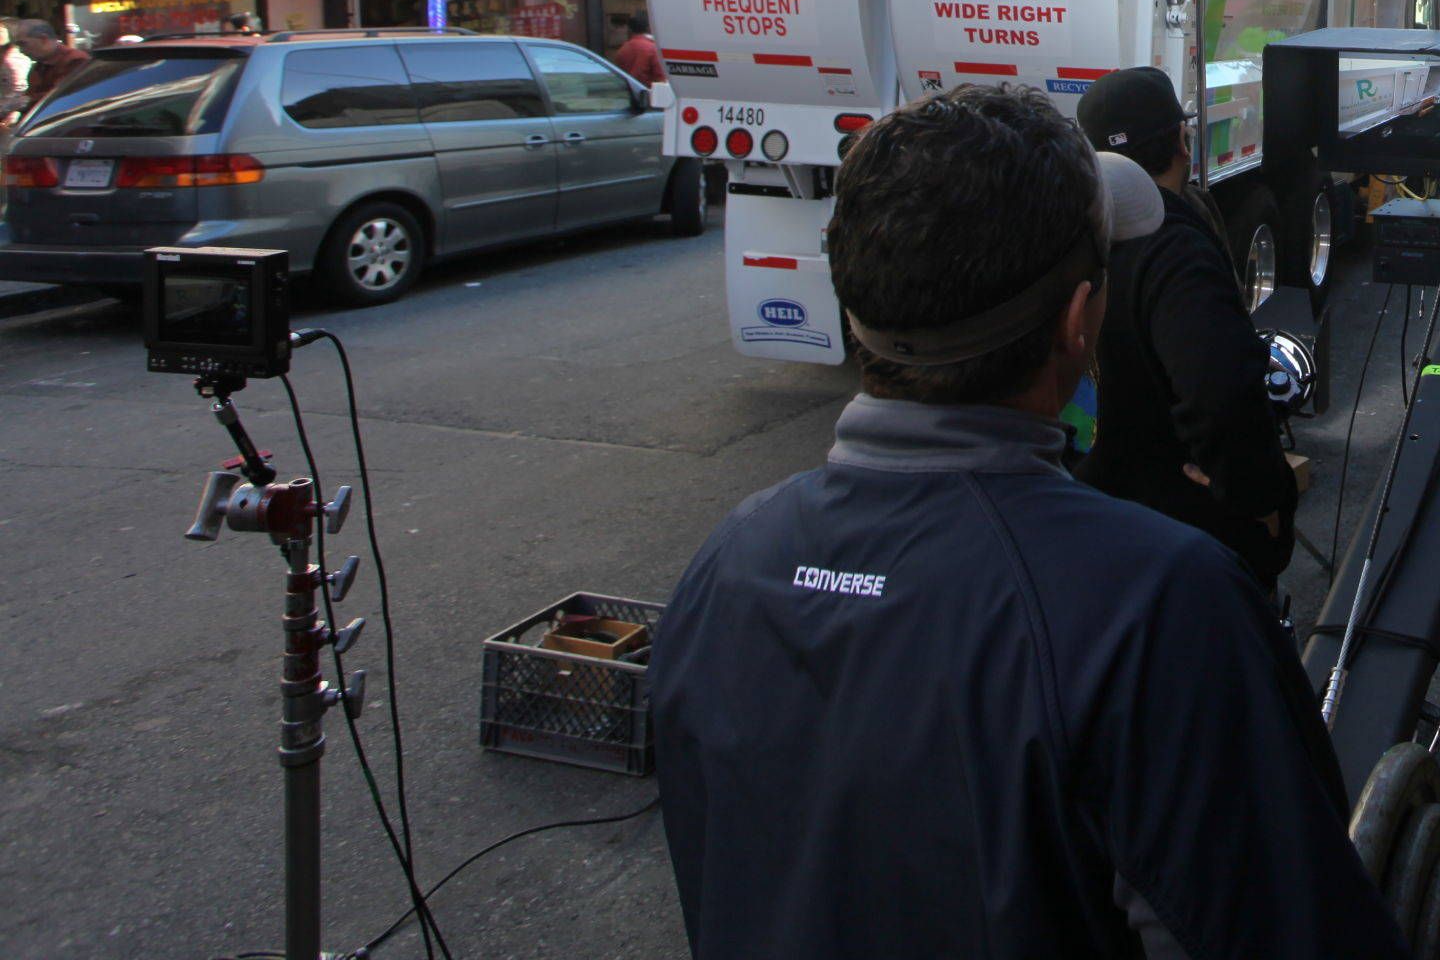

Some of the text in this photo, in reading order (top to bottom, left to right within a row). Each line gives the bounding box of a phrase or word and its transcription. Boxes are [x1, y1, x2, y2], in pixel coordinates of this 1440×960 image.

[934, 2, 1067, 24] WIDE RIGHT
[722, 15, 787, 37] STOPS
[963, 27, 1040, 46] TURNS
[1053, 82, 1090, 92] RECYC
[717, 105, 765, 126] 14480
[764, 307, 803, 320] HEIL
[793, 565, 887, 597] CONVERSE
